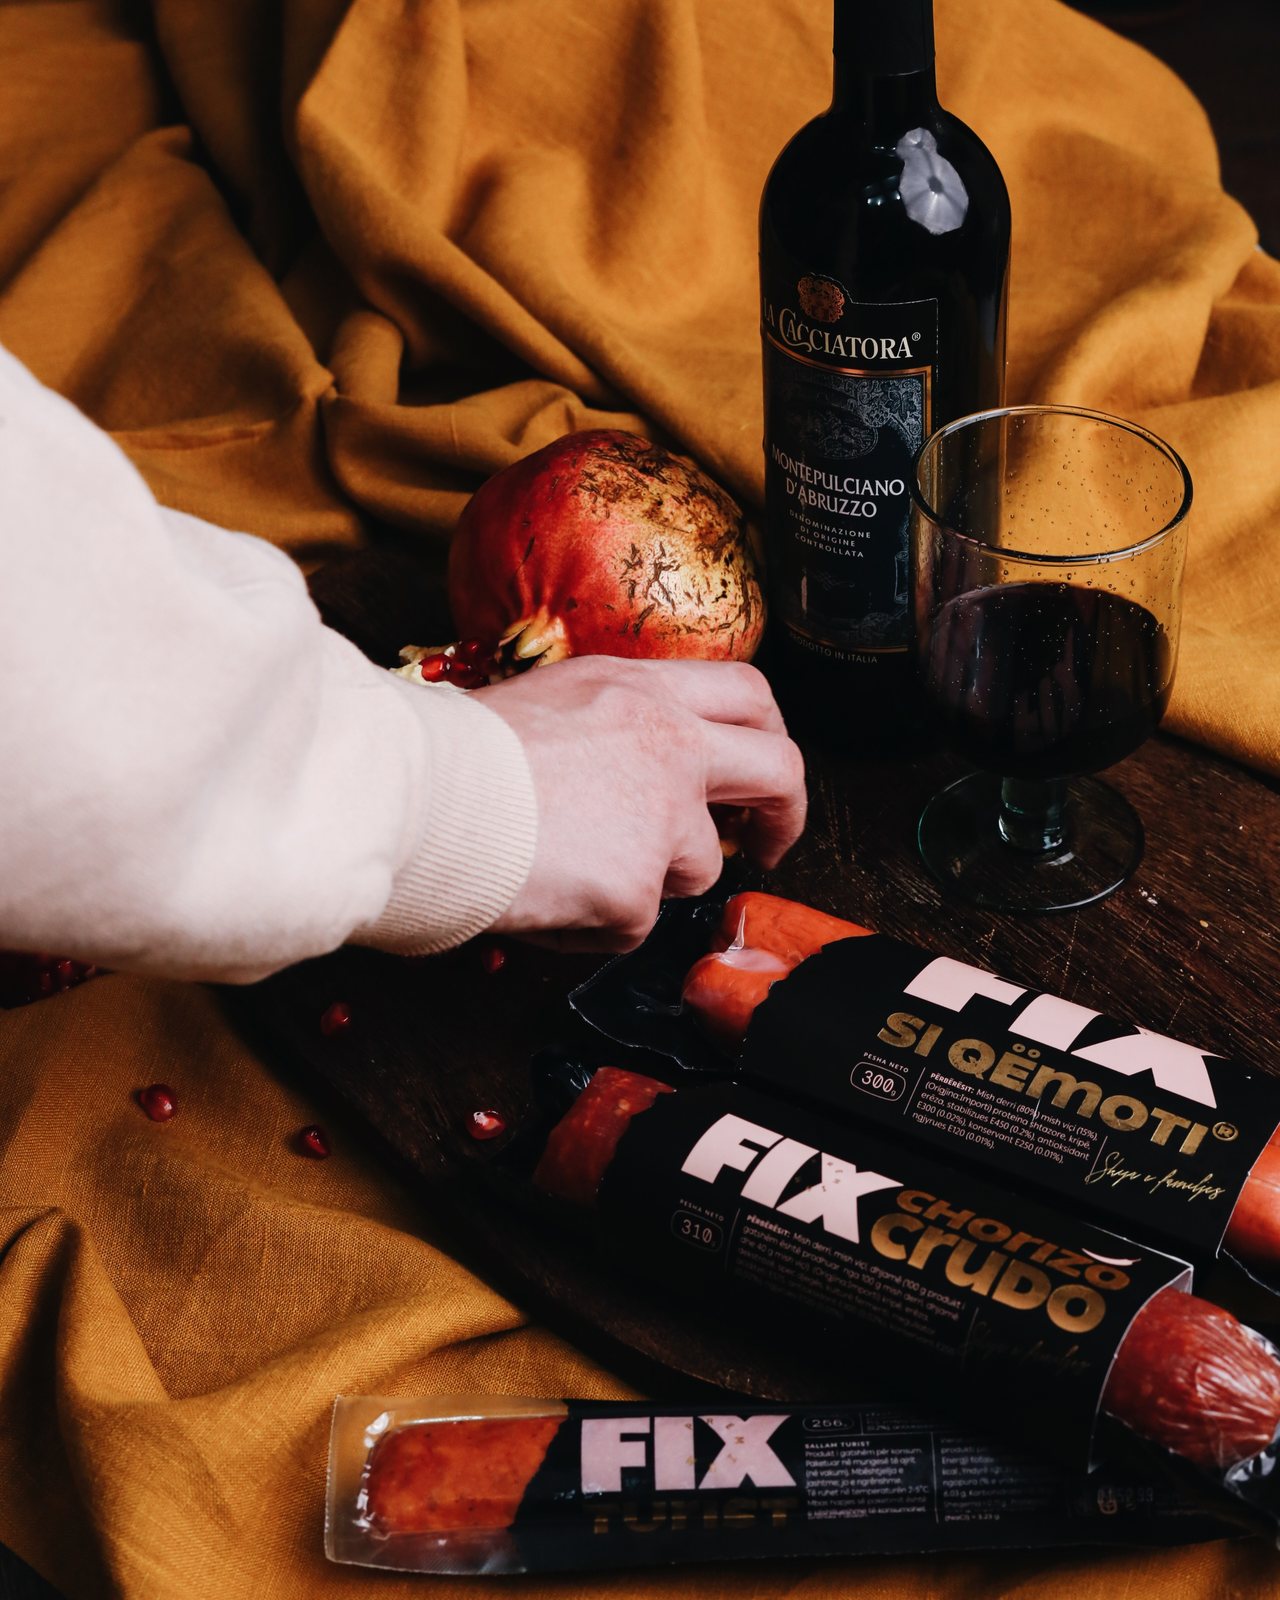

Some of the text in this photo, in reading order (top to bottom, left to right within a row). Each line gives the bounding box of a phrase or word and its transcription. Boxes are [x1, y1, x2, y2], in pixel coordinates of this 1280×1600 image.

[771, 442, 905, 497] MONTEPULCIANO
[785, 477, 877, 518] D'ABRUZZO
[789, 508, 871, 539] DENOMINAZIONE
[800, 525, 856, 548] DI ORIGINE
[795, 532, 864, 558] CONTROLLATA
[848, 653, 878, 664] ITALIA
[877, 1012, 943, 1058] SI
[863, 1051, 909, 1073] PESHA NETO
[912, 1110, 946, 1131] ngjyrues
[948, 1124, 964, 1137] E120
[917, 1101, 935, 1114] E300
[968, 1119, 1013, 1144] konservant
[1014, 1138, 1033, 1151] E250
[976, 1088, 995, 1102] Mish
[996, 1095, 1016, 1110] derri
[1041, 1112, 1060, 1126] mish
[992, 1105, 1028, 1127] proteina
[947, 1099, 988, 1123] stabilizues
[990, 1116, 1008, 1130] E450
[1037, 1133, 1089, 1161] antioksidant
[680, 1113, 904, 1244] FIX
[580, 1413, 798, 1493] FIX
